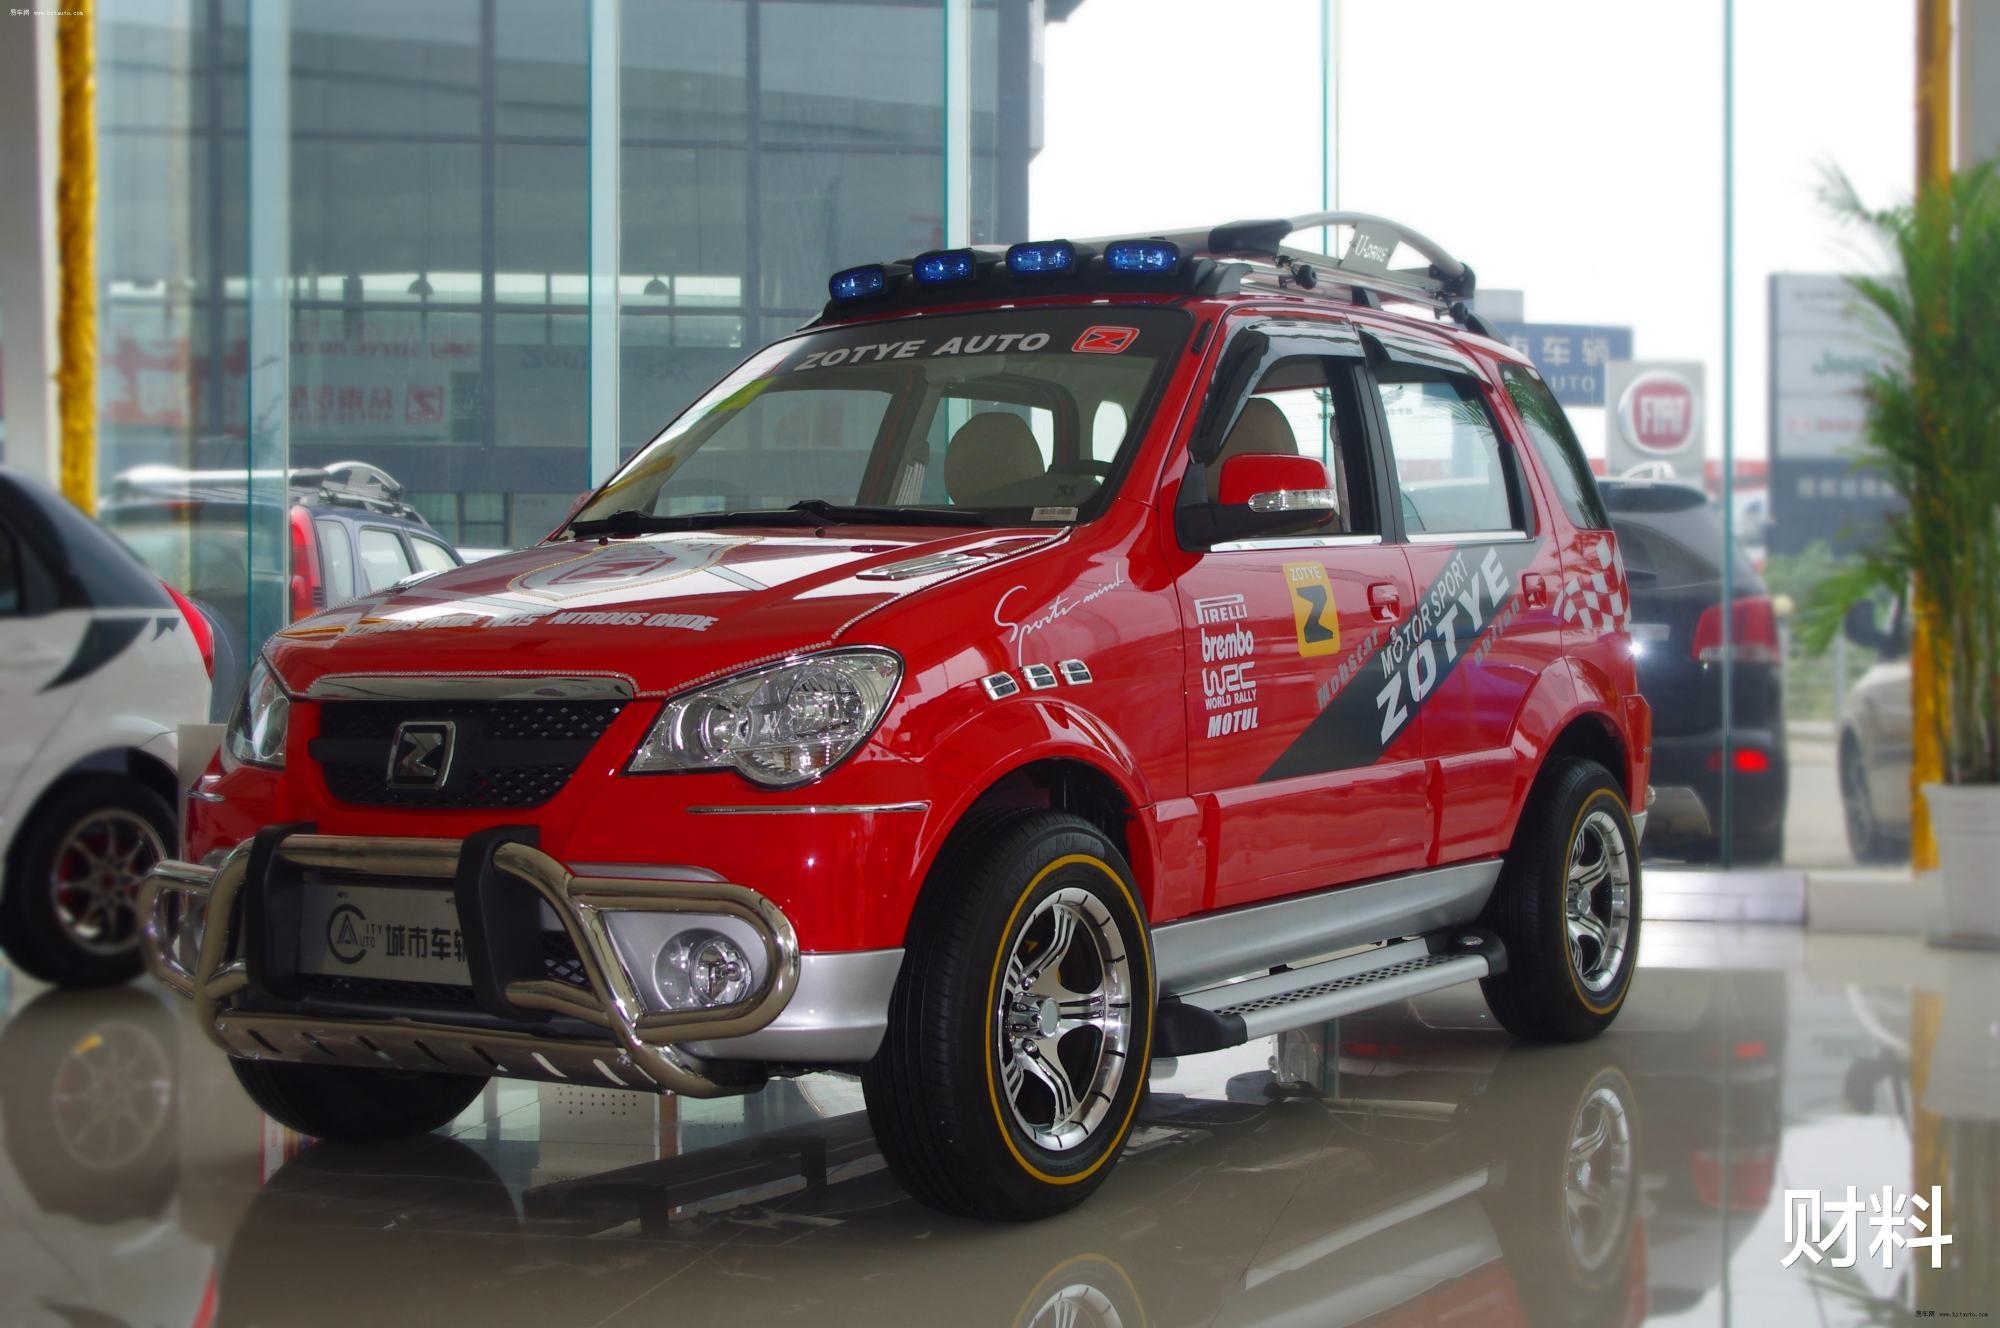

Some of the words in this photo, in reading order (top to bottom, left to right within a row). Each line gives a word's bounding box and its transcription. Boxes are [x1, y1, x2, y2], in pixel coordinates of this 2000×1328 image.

[794, 339, 926, 371] ZOTYE
[932, 333, 1050, 355] AUTO
[1640, 395, 1690, 436] FIAT
[1289, 565, 1321, 581] ZOTYE
[545, 611, 650, 625] NITROUS
[643, 613, 719, 632] OXIDE
[1194, 594, 1247, 624] PIRELLI
[1381, 603, 1432, 679] MOTOR
[1431, 551, 1468, 618] SPORT
[1201, 623, 1254, 663] brembo
[1376, 546, 1510, 745] ZOTYE
[1202, 661, 1256, 697] WRC
[1205, 694, 1232, 711] WORLD
[1234, 689, 1257, 706] RALLY
[1207, 707, 1258, 739] MOTUL
